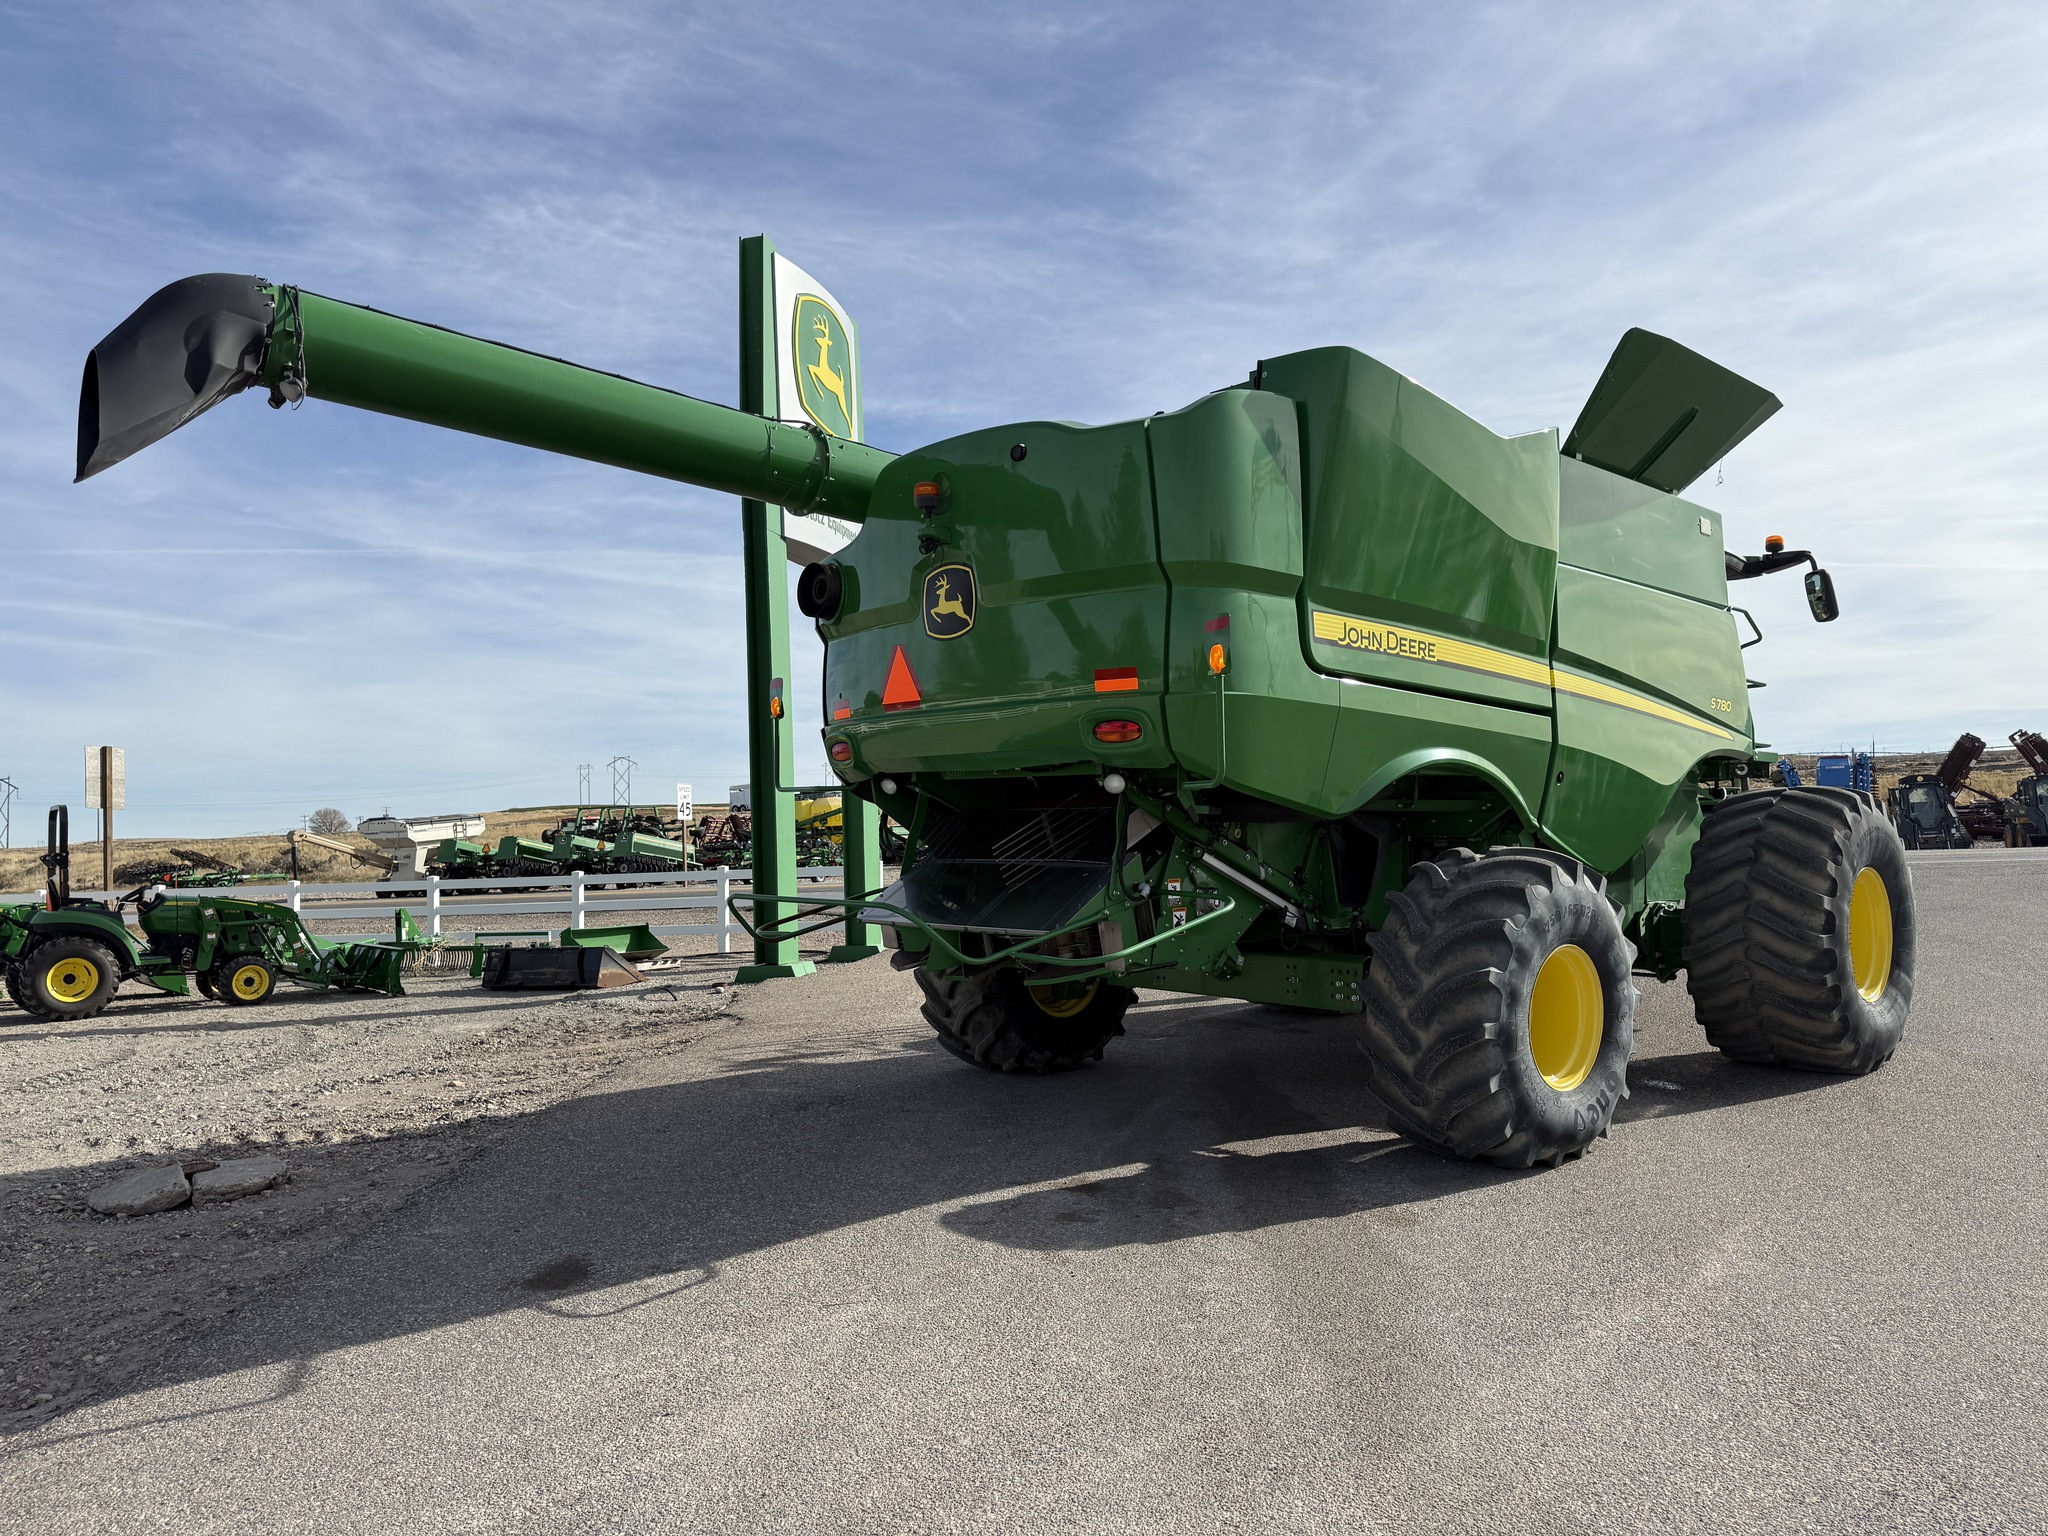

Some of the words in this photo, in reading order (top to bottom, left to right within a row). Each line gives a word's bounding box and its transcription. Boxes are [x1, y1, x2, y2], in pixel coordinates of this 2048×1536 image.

[1338, 622, 1382, 650] JOHN
[1386, 630, 1436, 659] DEERE
[1710, 697, 1732, 712] S780
[679, 802, 691, 816] 45
